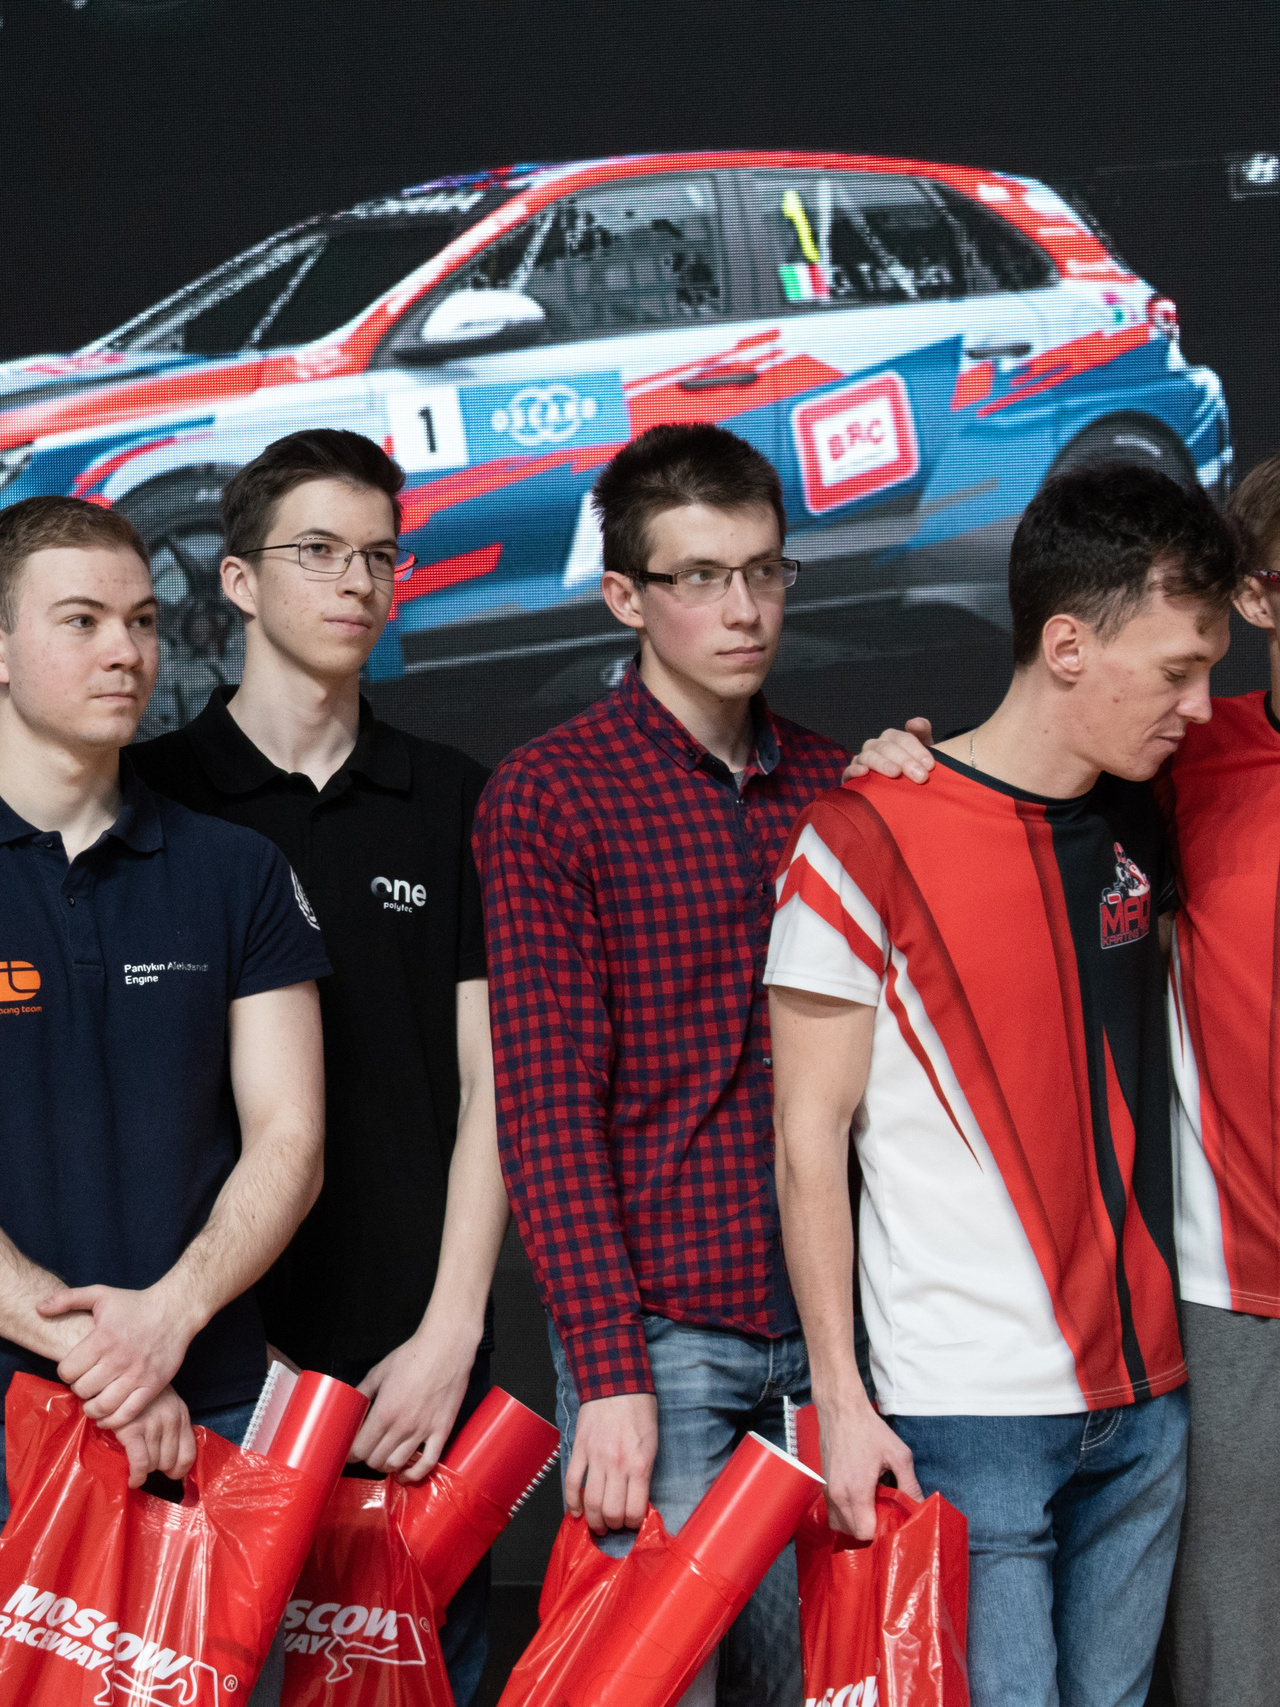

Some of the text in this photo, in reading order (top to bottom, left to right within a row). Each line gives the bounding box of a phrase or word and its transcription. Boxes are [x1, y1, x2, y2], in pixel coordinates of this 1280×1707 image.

[418, 405, 437, 453] 1
[827, 418, 885, 461] BRC
[371, 877, 427, 907] one
[383, 902, 413, 914] polytec
[124, 963, 166, 974] Pantykin
[125, 975, 159, 986] Engine
[21, 1005, 43, 1013] team
[3, 1583, 193, 1680] MOSCOW
